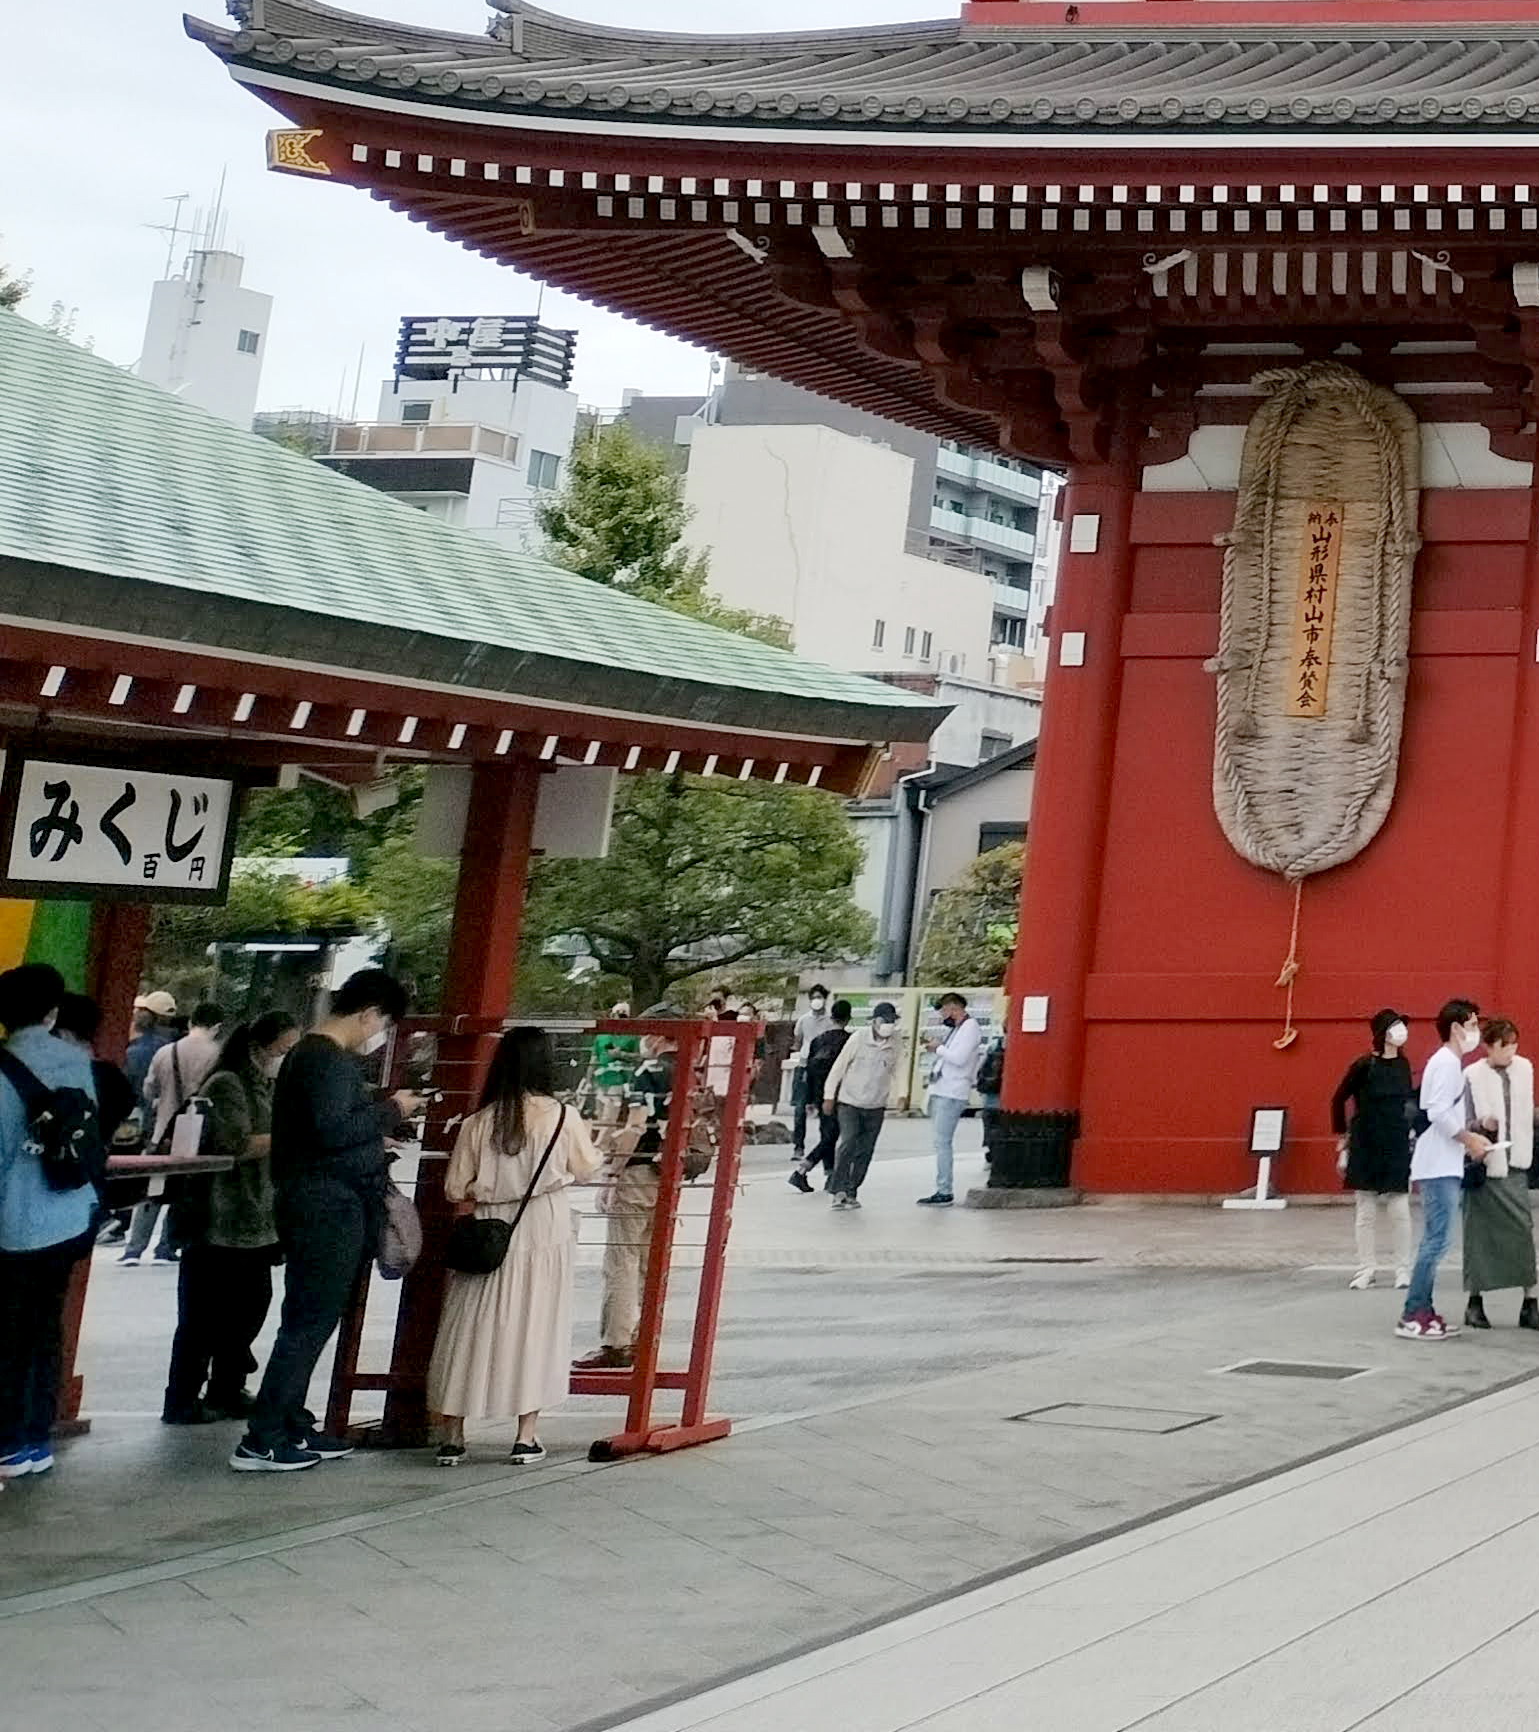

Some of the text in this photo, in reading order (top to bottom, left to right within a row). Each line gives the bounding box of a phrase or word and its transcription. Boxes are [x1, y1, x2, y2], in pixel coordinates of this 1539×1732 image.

[1296, 525, 1332, 708] 山形県村山市奉賛会
[30, 780, 208, 866] みくじ
[144, 853, 205, 881] 百円
